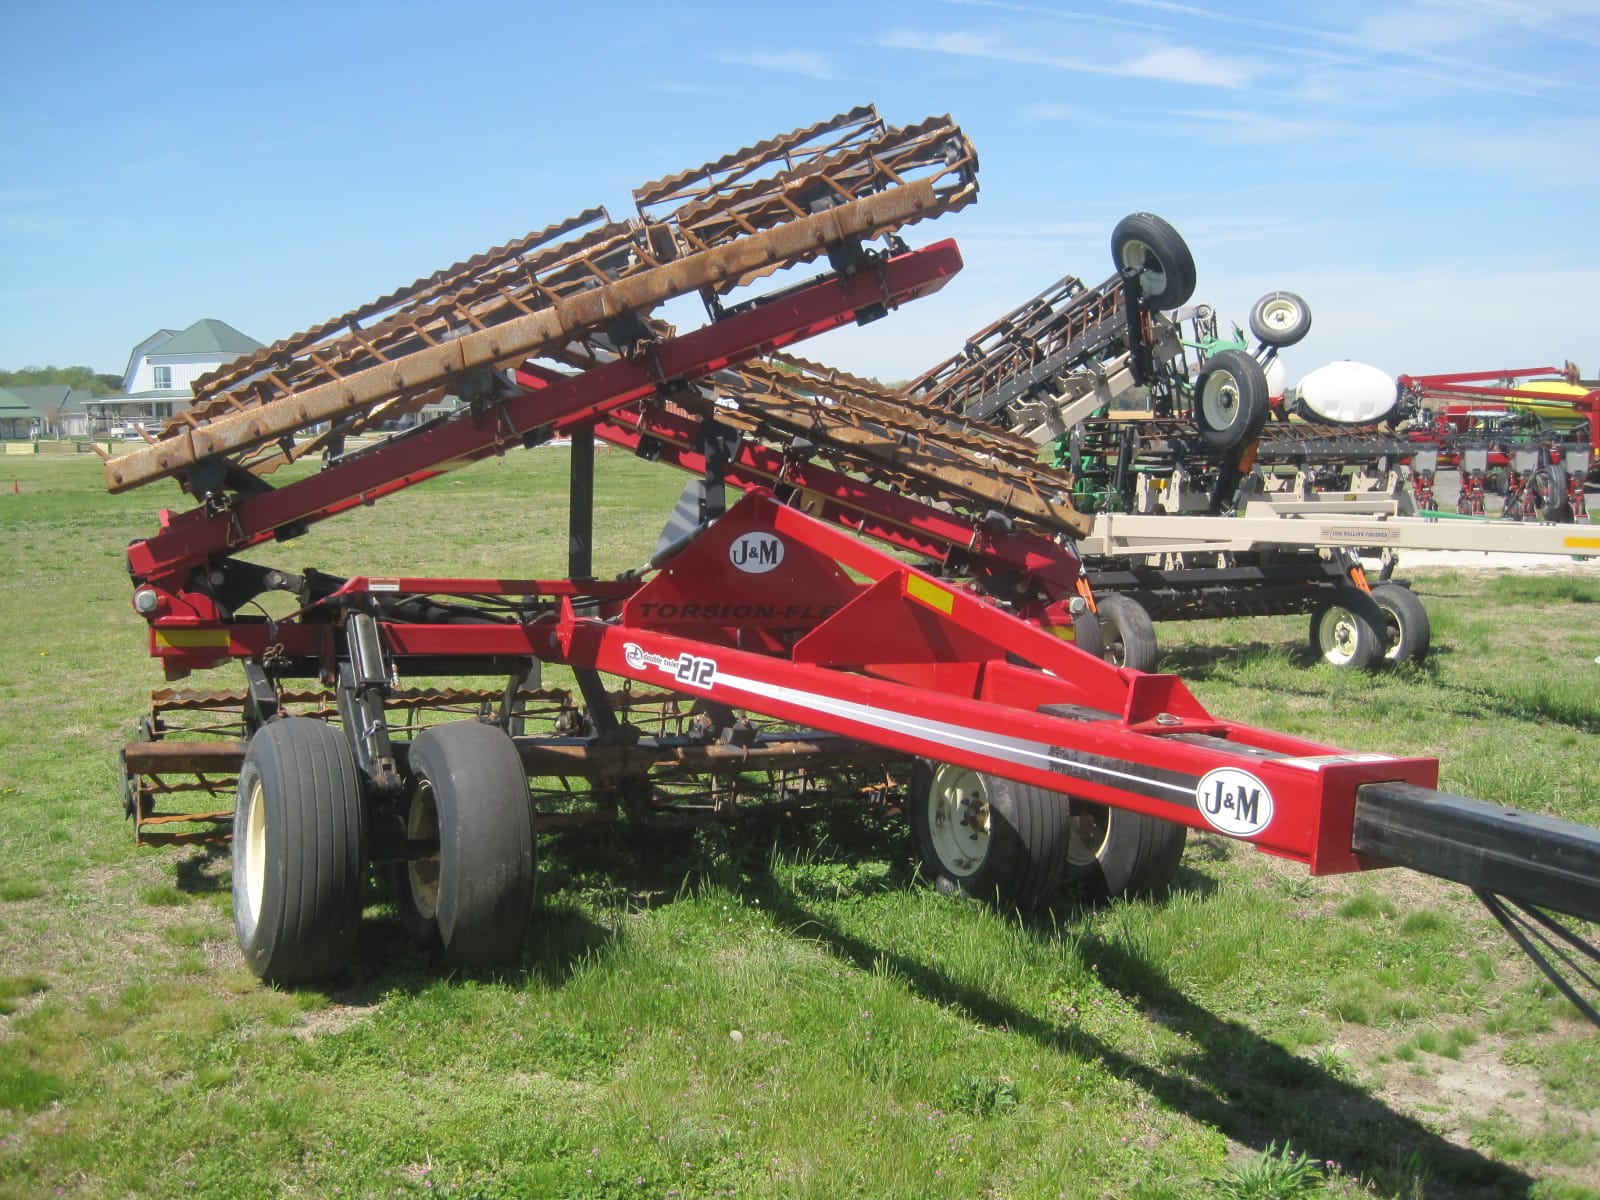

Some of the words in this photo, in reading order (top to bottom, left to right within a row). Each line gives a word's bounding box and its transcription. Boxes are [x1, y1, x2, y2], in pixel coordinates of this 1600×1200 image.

[732, 540, 778, 565] J&M
[639, 603, 836, 619] TORSION-FLE
[643, 653, 663, 665] double
[677, 656, 715, 686] 212
[1204, 780, 1262, 825] J&M
